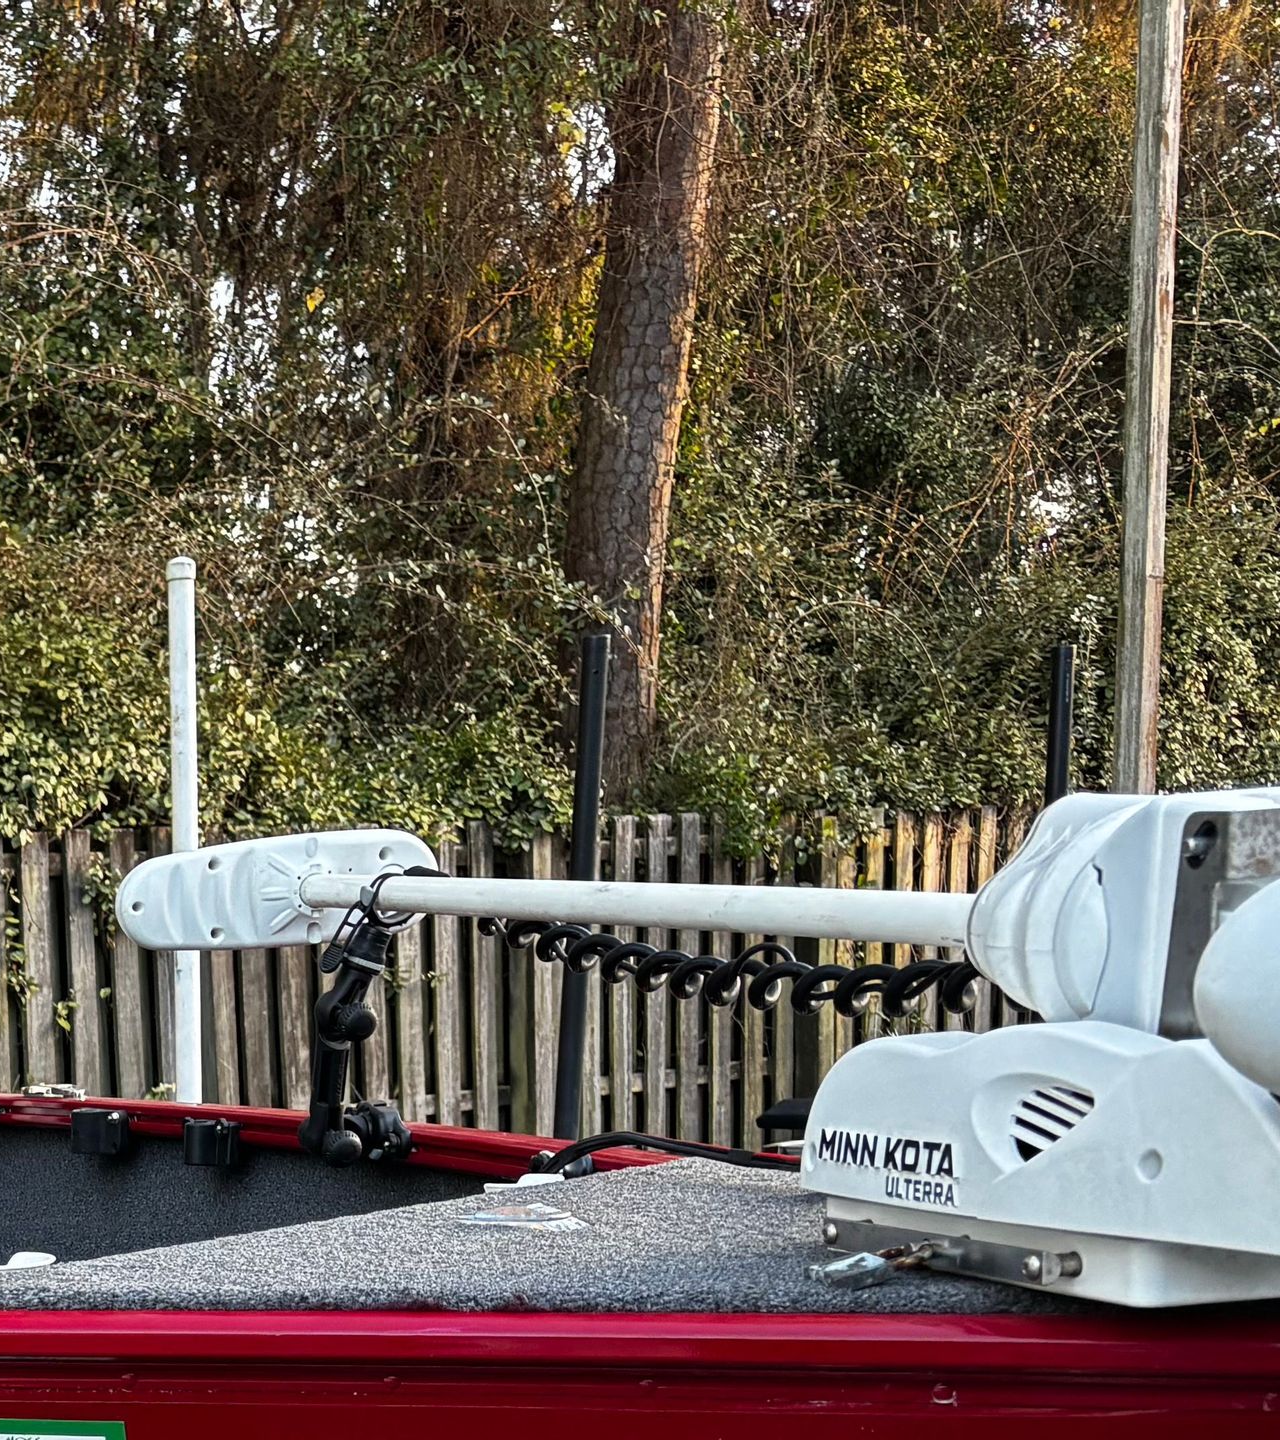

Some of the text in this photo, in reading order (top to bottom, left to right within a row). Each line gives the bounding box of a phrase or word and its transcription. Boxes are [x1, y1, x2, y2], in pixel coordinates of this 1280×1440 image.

[818, 1128, 954, 1178] MINN KOTA
[885, 1175, 958, 1208] ULTERRA
